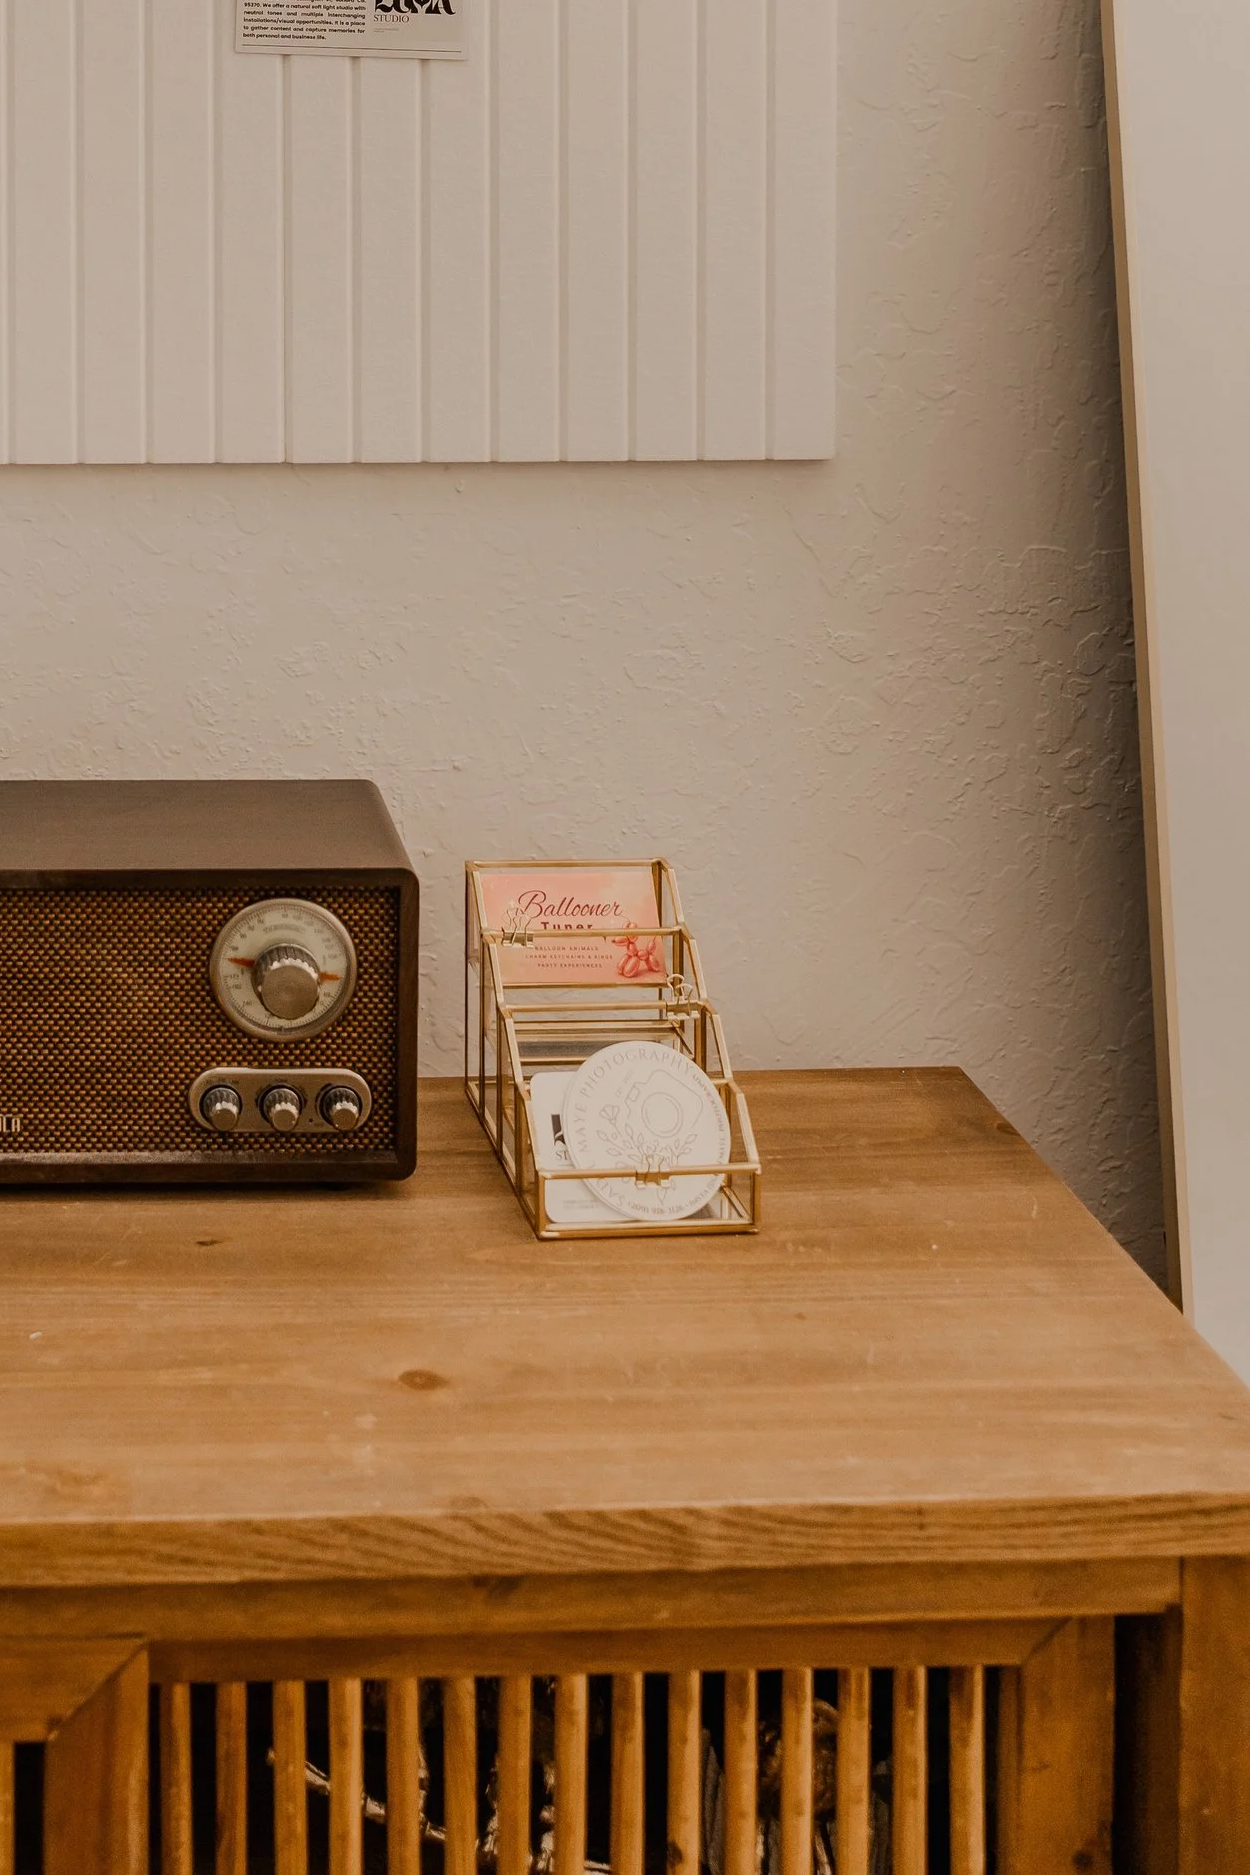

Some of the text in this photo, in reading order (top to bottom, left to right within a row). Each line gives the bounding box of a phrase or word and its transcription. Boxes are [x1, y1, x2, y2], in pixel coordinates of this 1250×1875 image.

[516, 890, 622, 918] Ballooner
[541, 922, 593, 930] Tuner
[580, 1046, 694, 1098] PHOTOGRAPHY
[574, 1104, 588, 1153] MAYE
